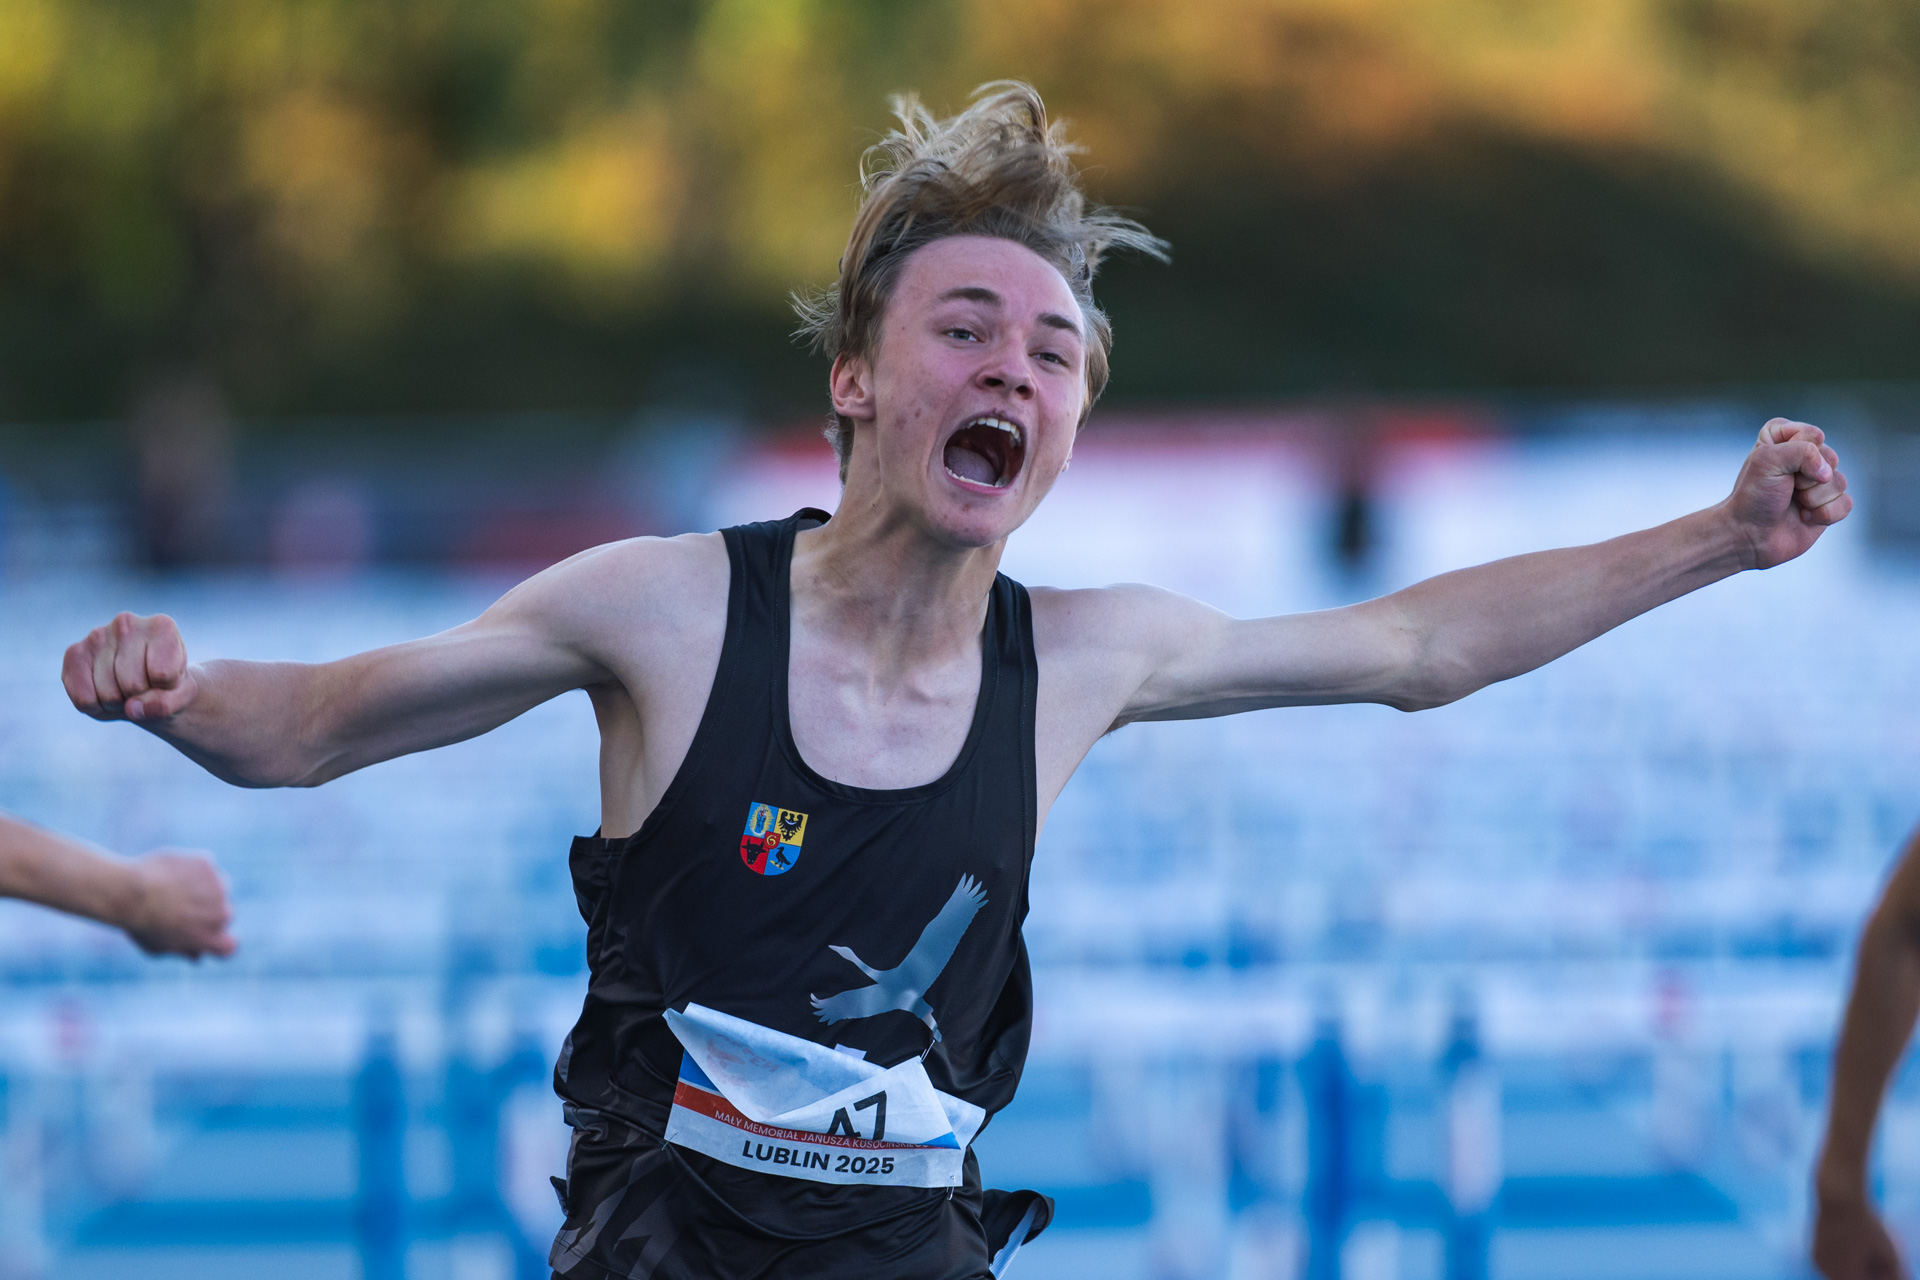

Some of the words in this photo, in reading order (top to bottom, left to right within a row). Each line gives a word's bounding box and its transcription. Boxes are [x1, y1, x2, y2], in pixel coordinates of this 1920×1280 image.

[715, 1110, 743, 1127] MAŁY
[743, 1120, 799, 1141] MEMORIAŁ
[801, 1132, 851, 1148] JANUSZA
[742, 1140, 831, 1171] LUBLIN
[834, 1154, 895, 1175] 2025
